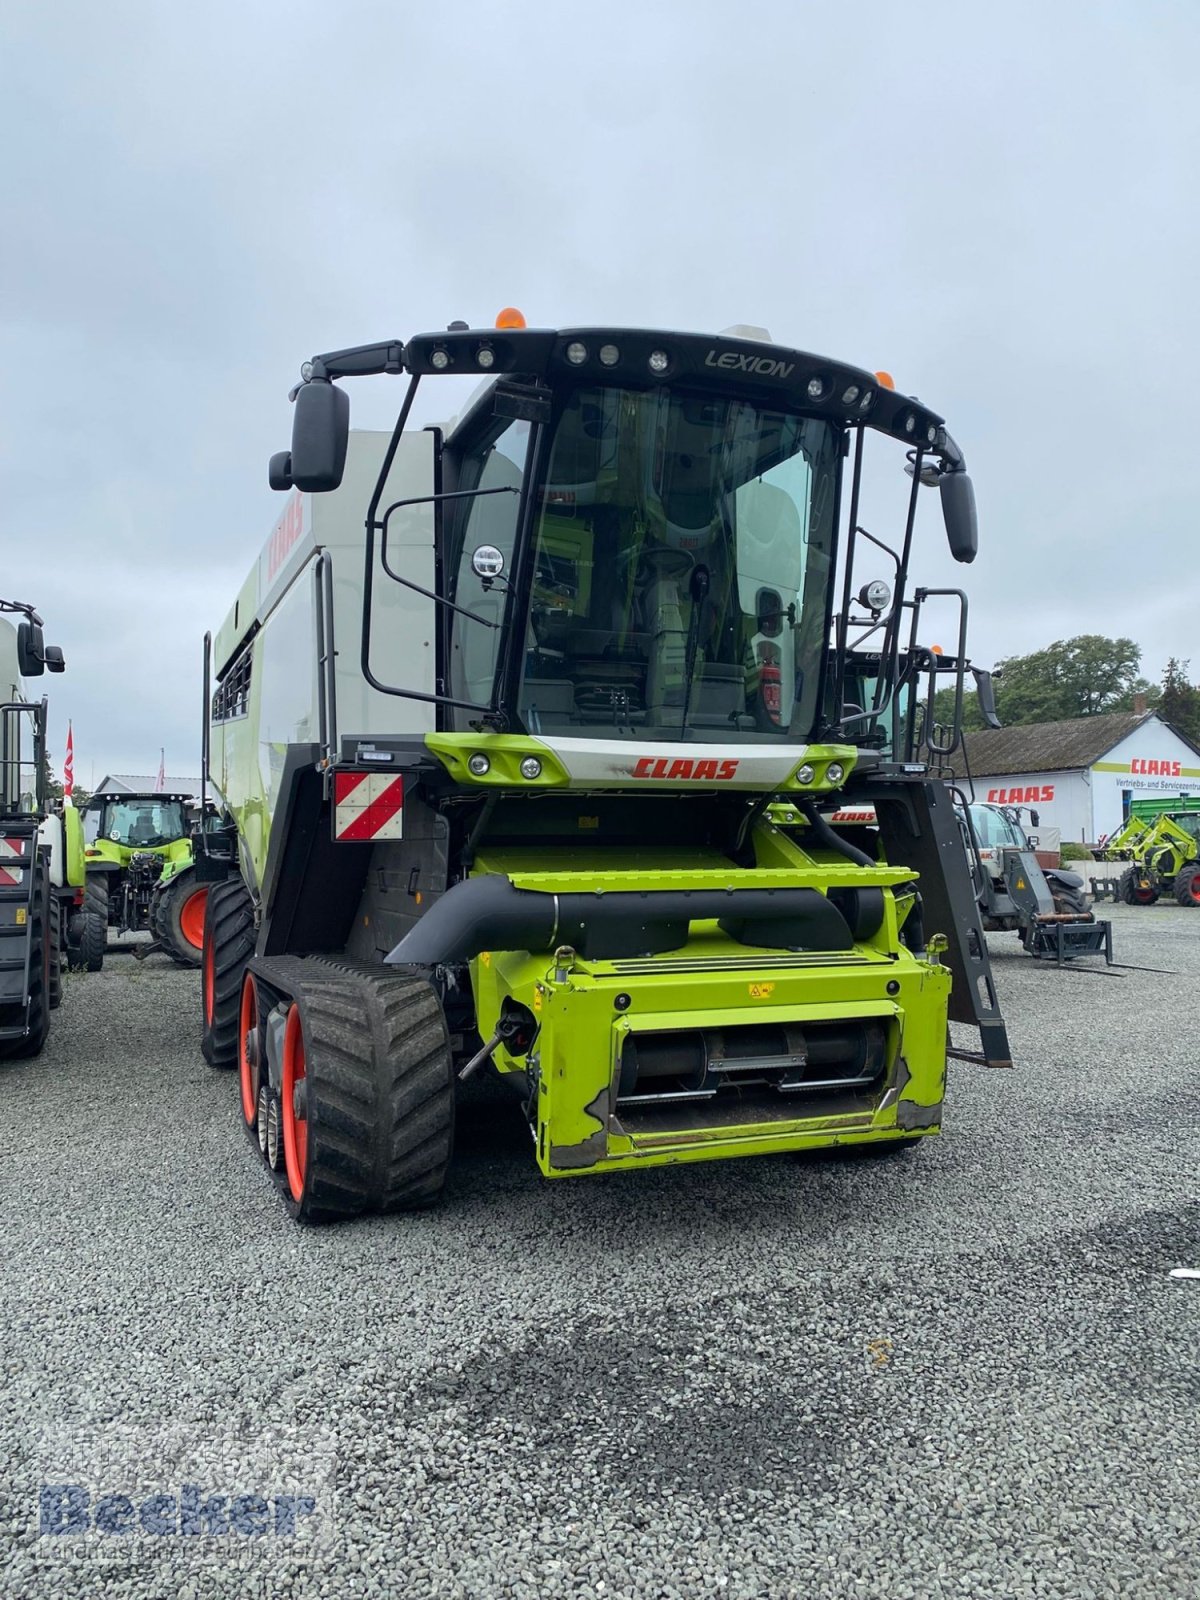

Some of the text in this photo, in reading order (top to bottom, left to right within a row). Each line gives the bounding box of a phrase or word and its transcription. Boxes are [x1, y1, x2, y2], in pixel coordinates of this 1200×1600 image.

[704, 350, 796, 378] LEXION
[631, 758, 739, 779] CLAAS
[1131, 758, 1181, 777] CLAAS
[987, 785, 1055, 804] CLAAS
[1116, 779, 1200, 791] Vertriebs- und Servicezentru
[832, 812, 875, 821] CLAAS
